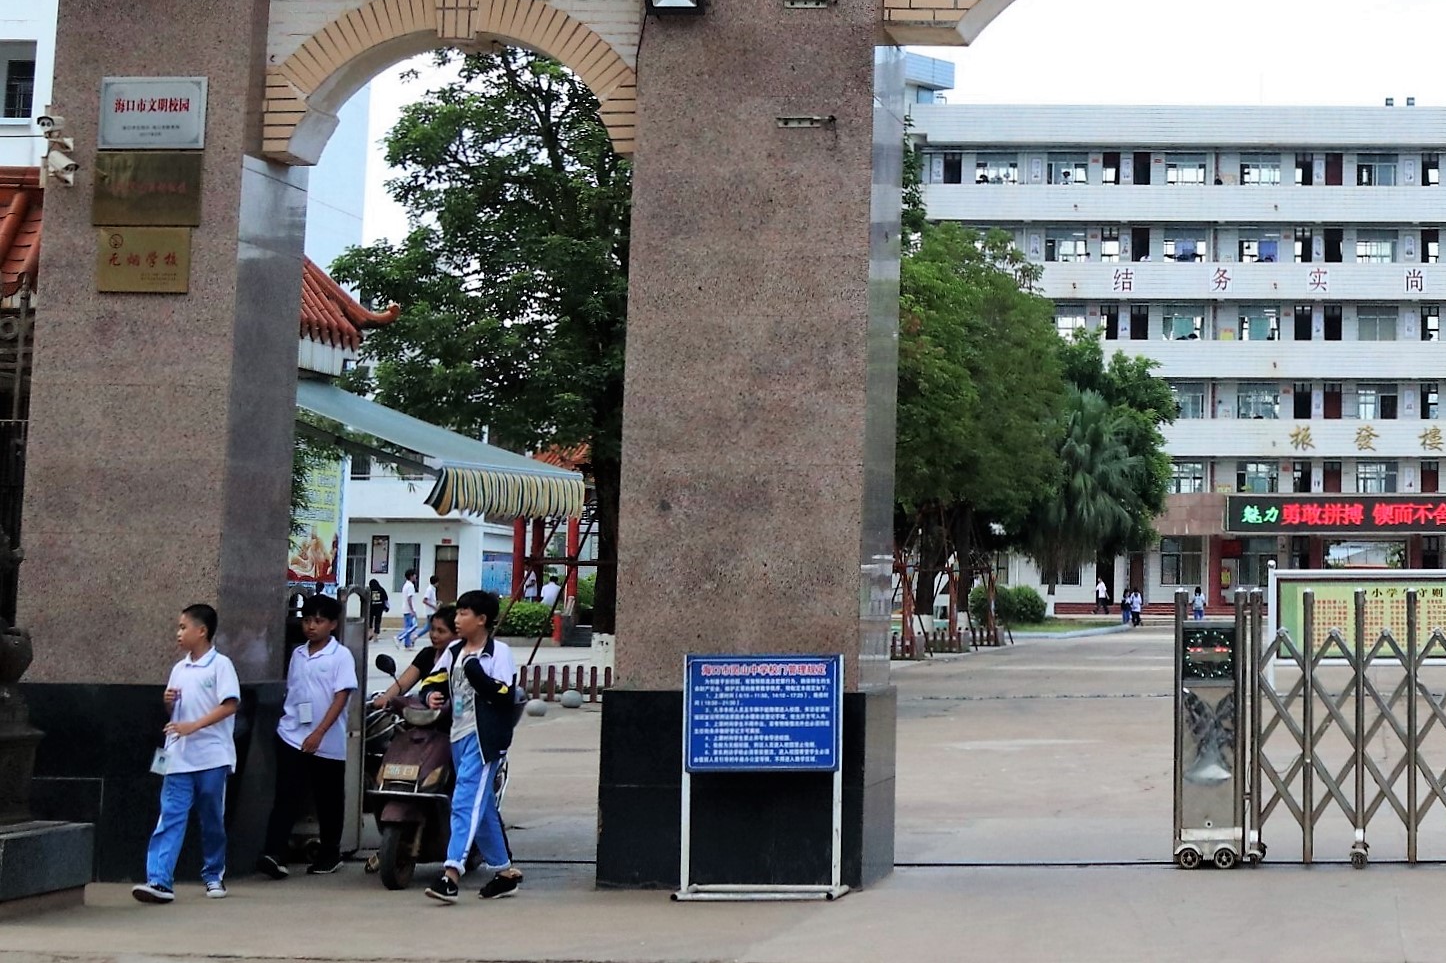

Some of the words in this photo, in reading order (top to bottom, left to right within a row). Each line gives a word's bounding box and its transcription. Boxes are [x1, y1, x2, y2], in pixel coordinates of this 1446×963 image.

[113, 98, 190, 113] 海口市文明校园
